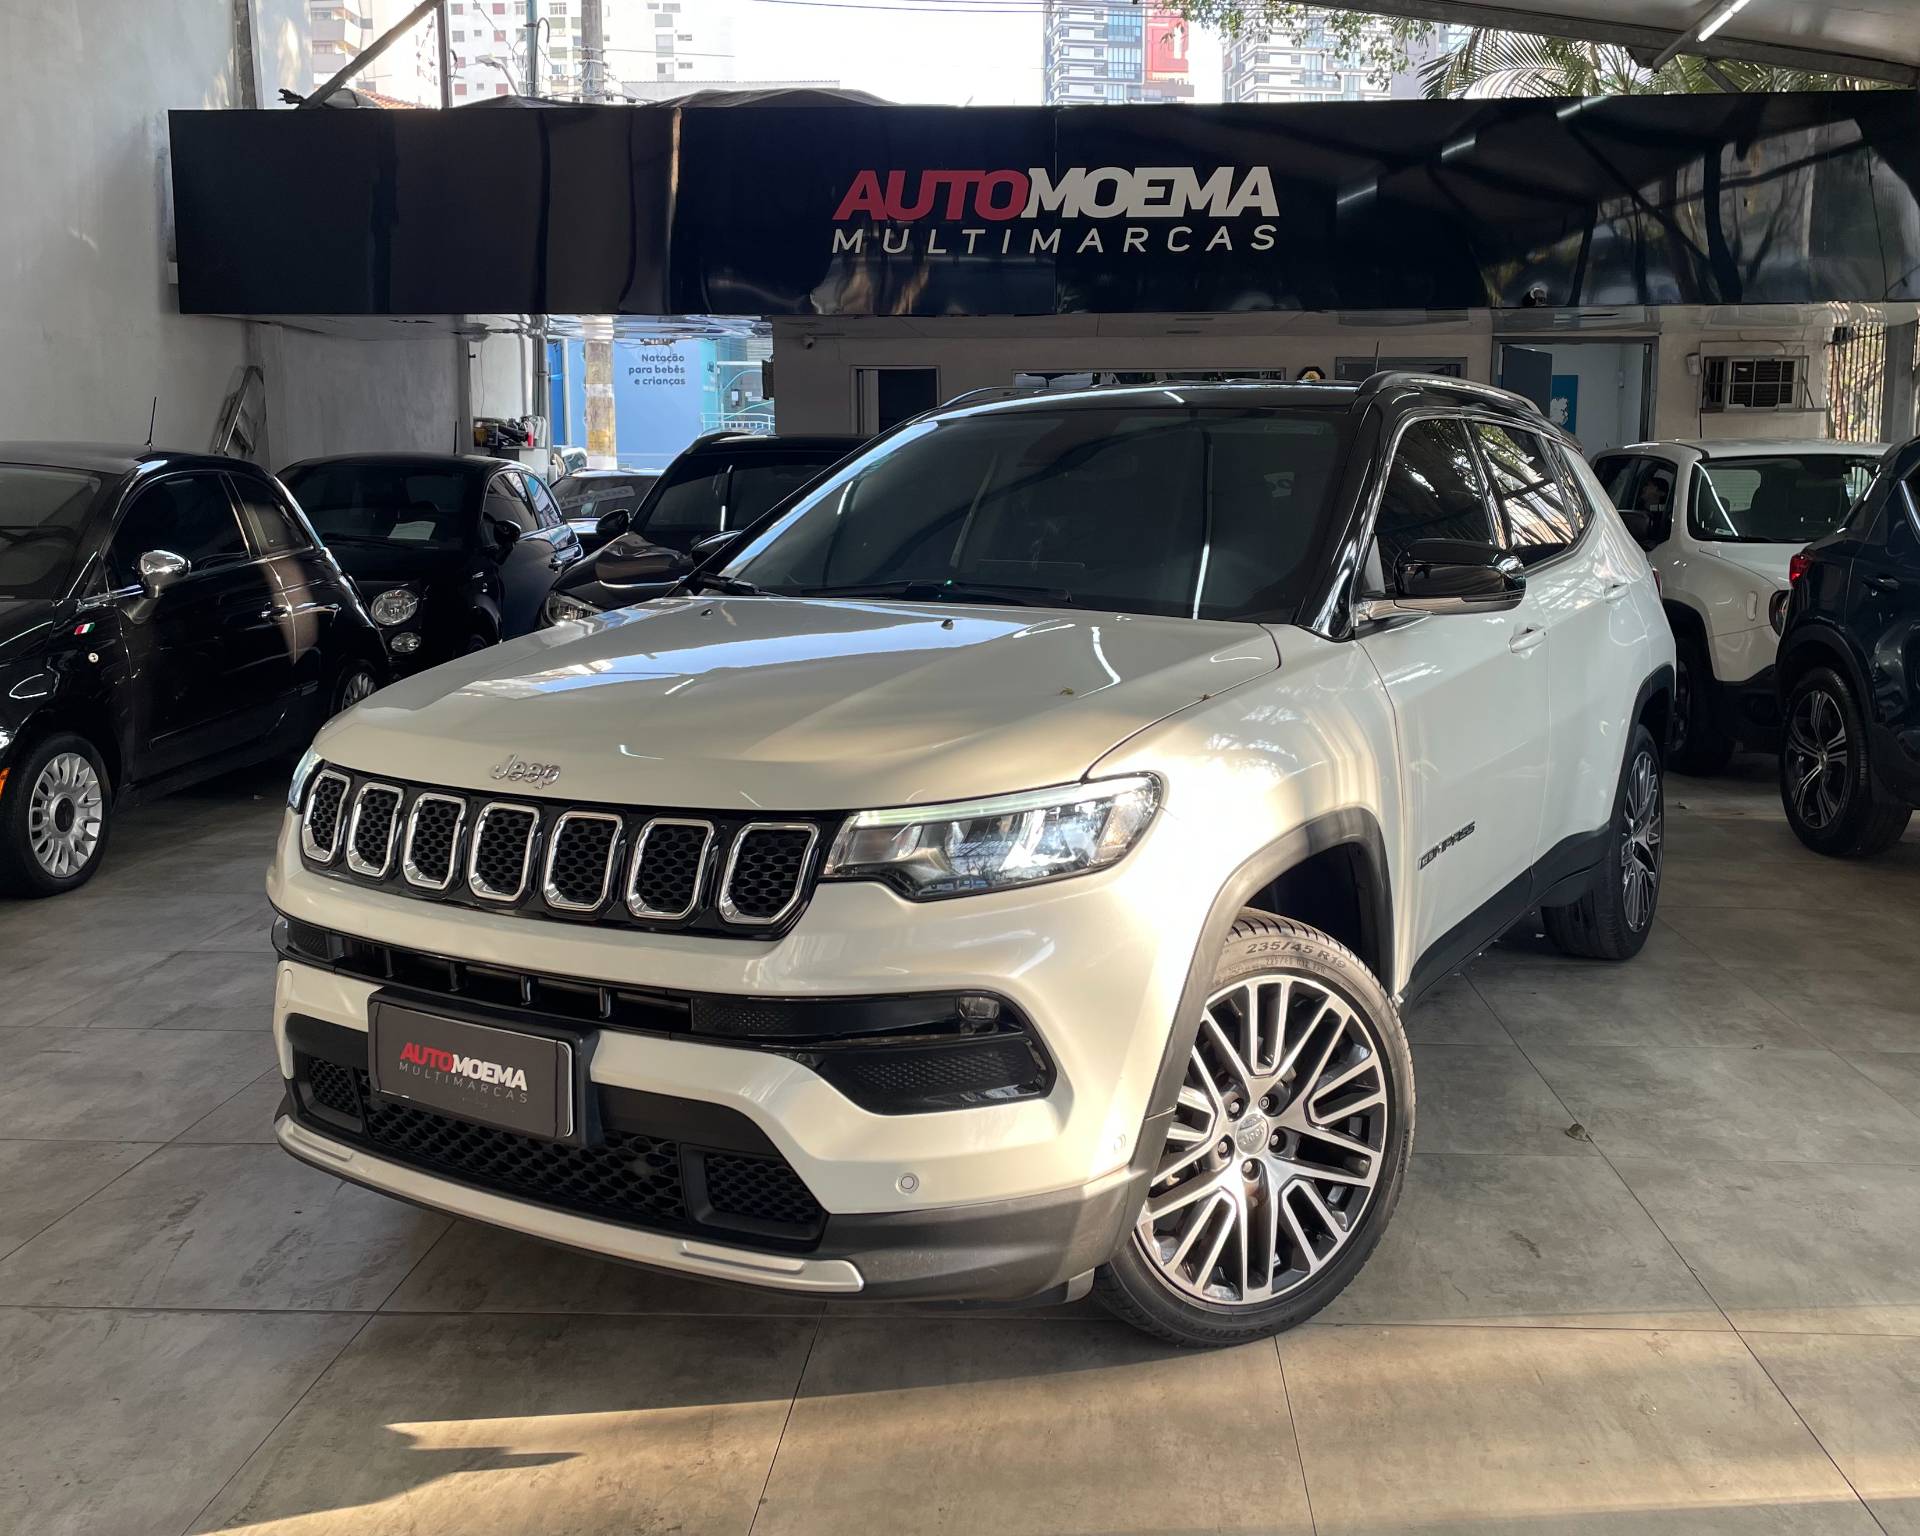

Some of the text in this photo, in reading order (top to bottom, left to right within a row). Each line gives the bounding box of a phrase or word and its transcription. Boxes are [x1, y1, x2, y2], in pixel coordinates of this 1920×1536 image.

[832, 225, 1277, 254] MULTIMARCAS
[628, 365, 685, 375] para bebês
[642, 376, 686, 386] crianças
[489, 752, 561, 789] Jeep
[1245, 941, 1314, 954] 235/45
[399, 1062, 528, 1104] MULTIMARCAS
